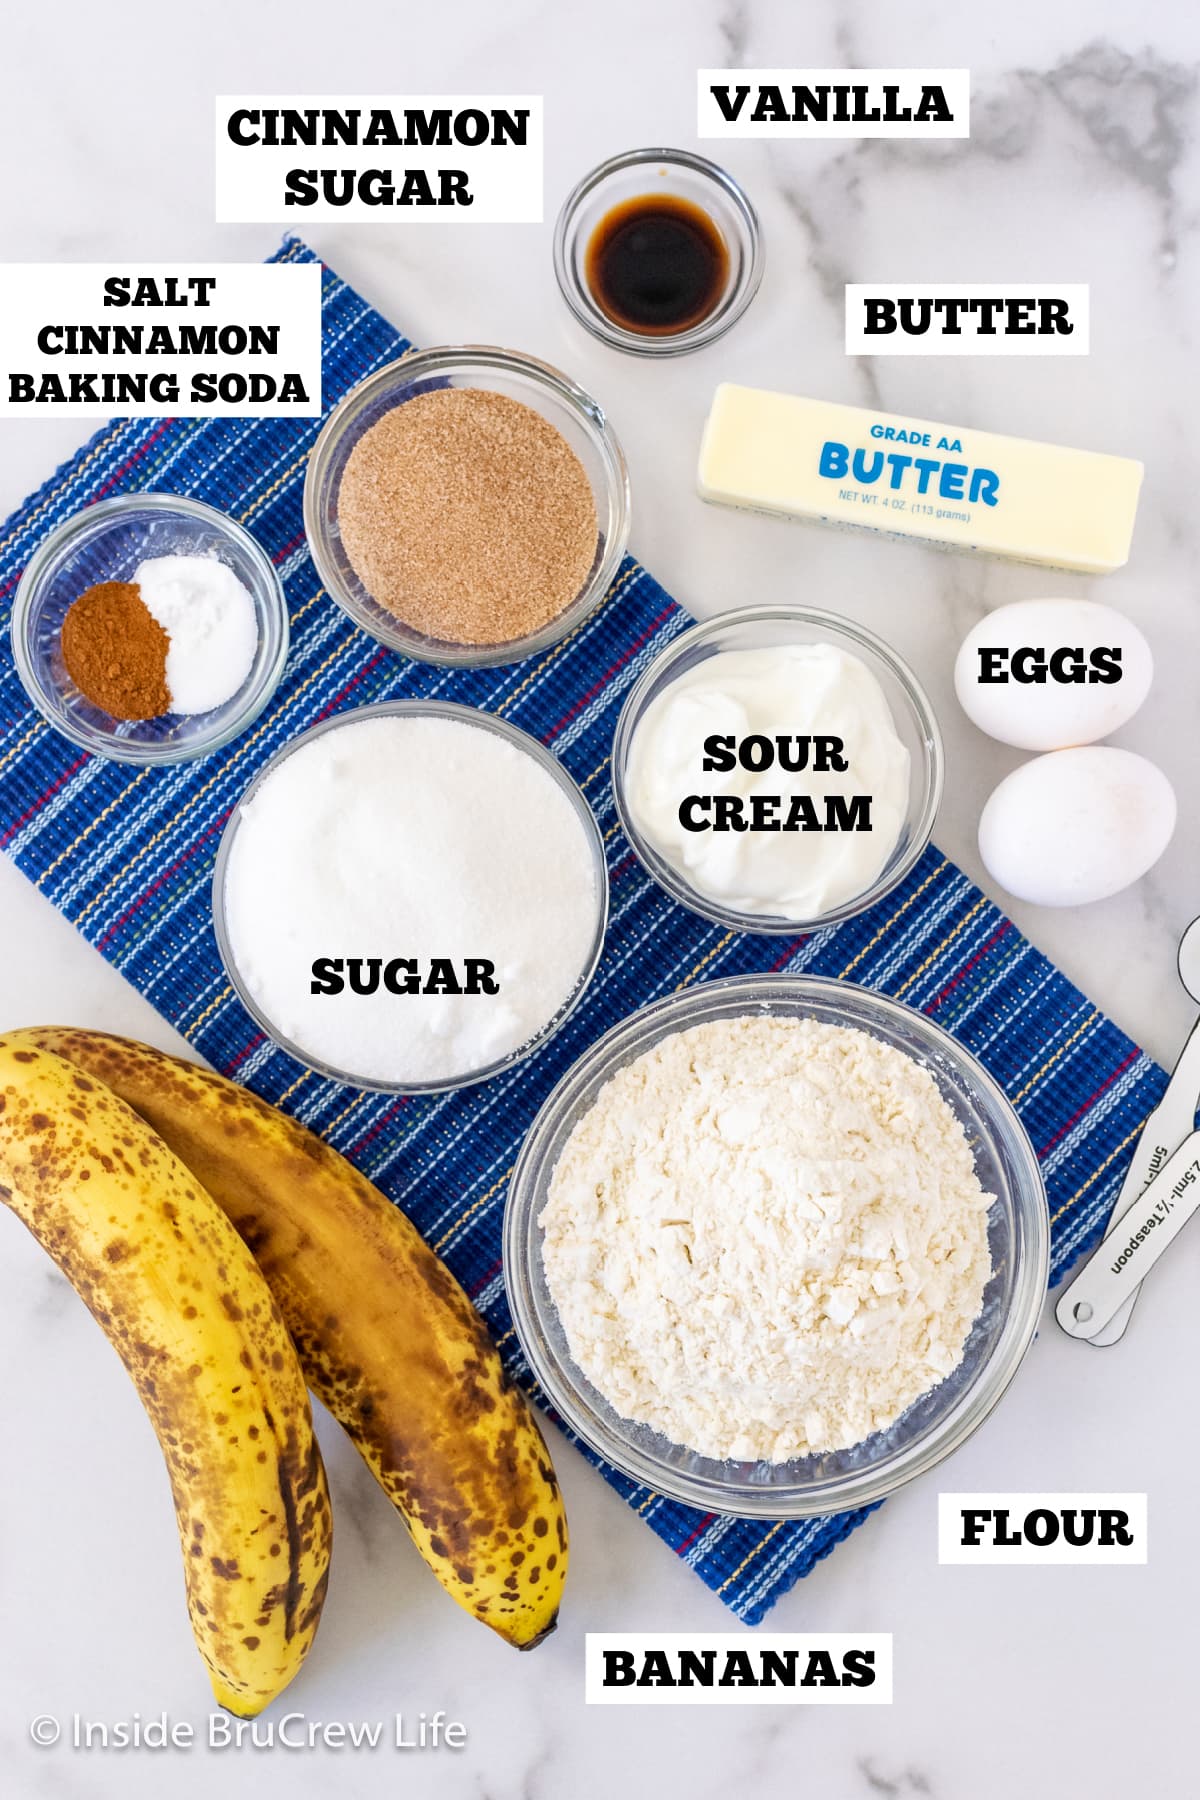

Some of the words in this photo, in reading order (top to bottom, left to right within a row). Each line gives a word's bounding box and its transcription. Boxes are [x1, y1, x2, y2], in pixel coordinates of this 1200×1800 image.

[870, 425, 931, 447] GRADE
[937, 437, 963, 453] AA
[819, 442, 1000, 507] BUTTER
[838, 489, 859, 501] NET
[882, 498, 889, 508] 4
[911, 503, 934, 515] (113
[936, 508, 971, 523] grams)
[1111, 1213, 1165, 1274] Teaspoon
